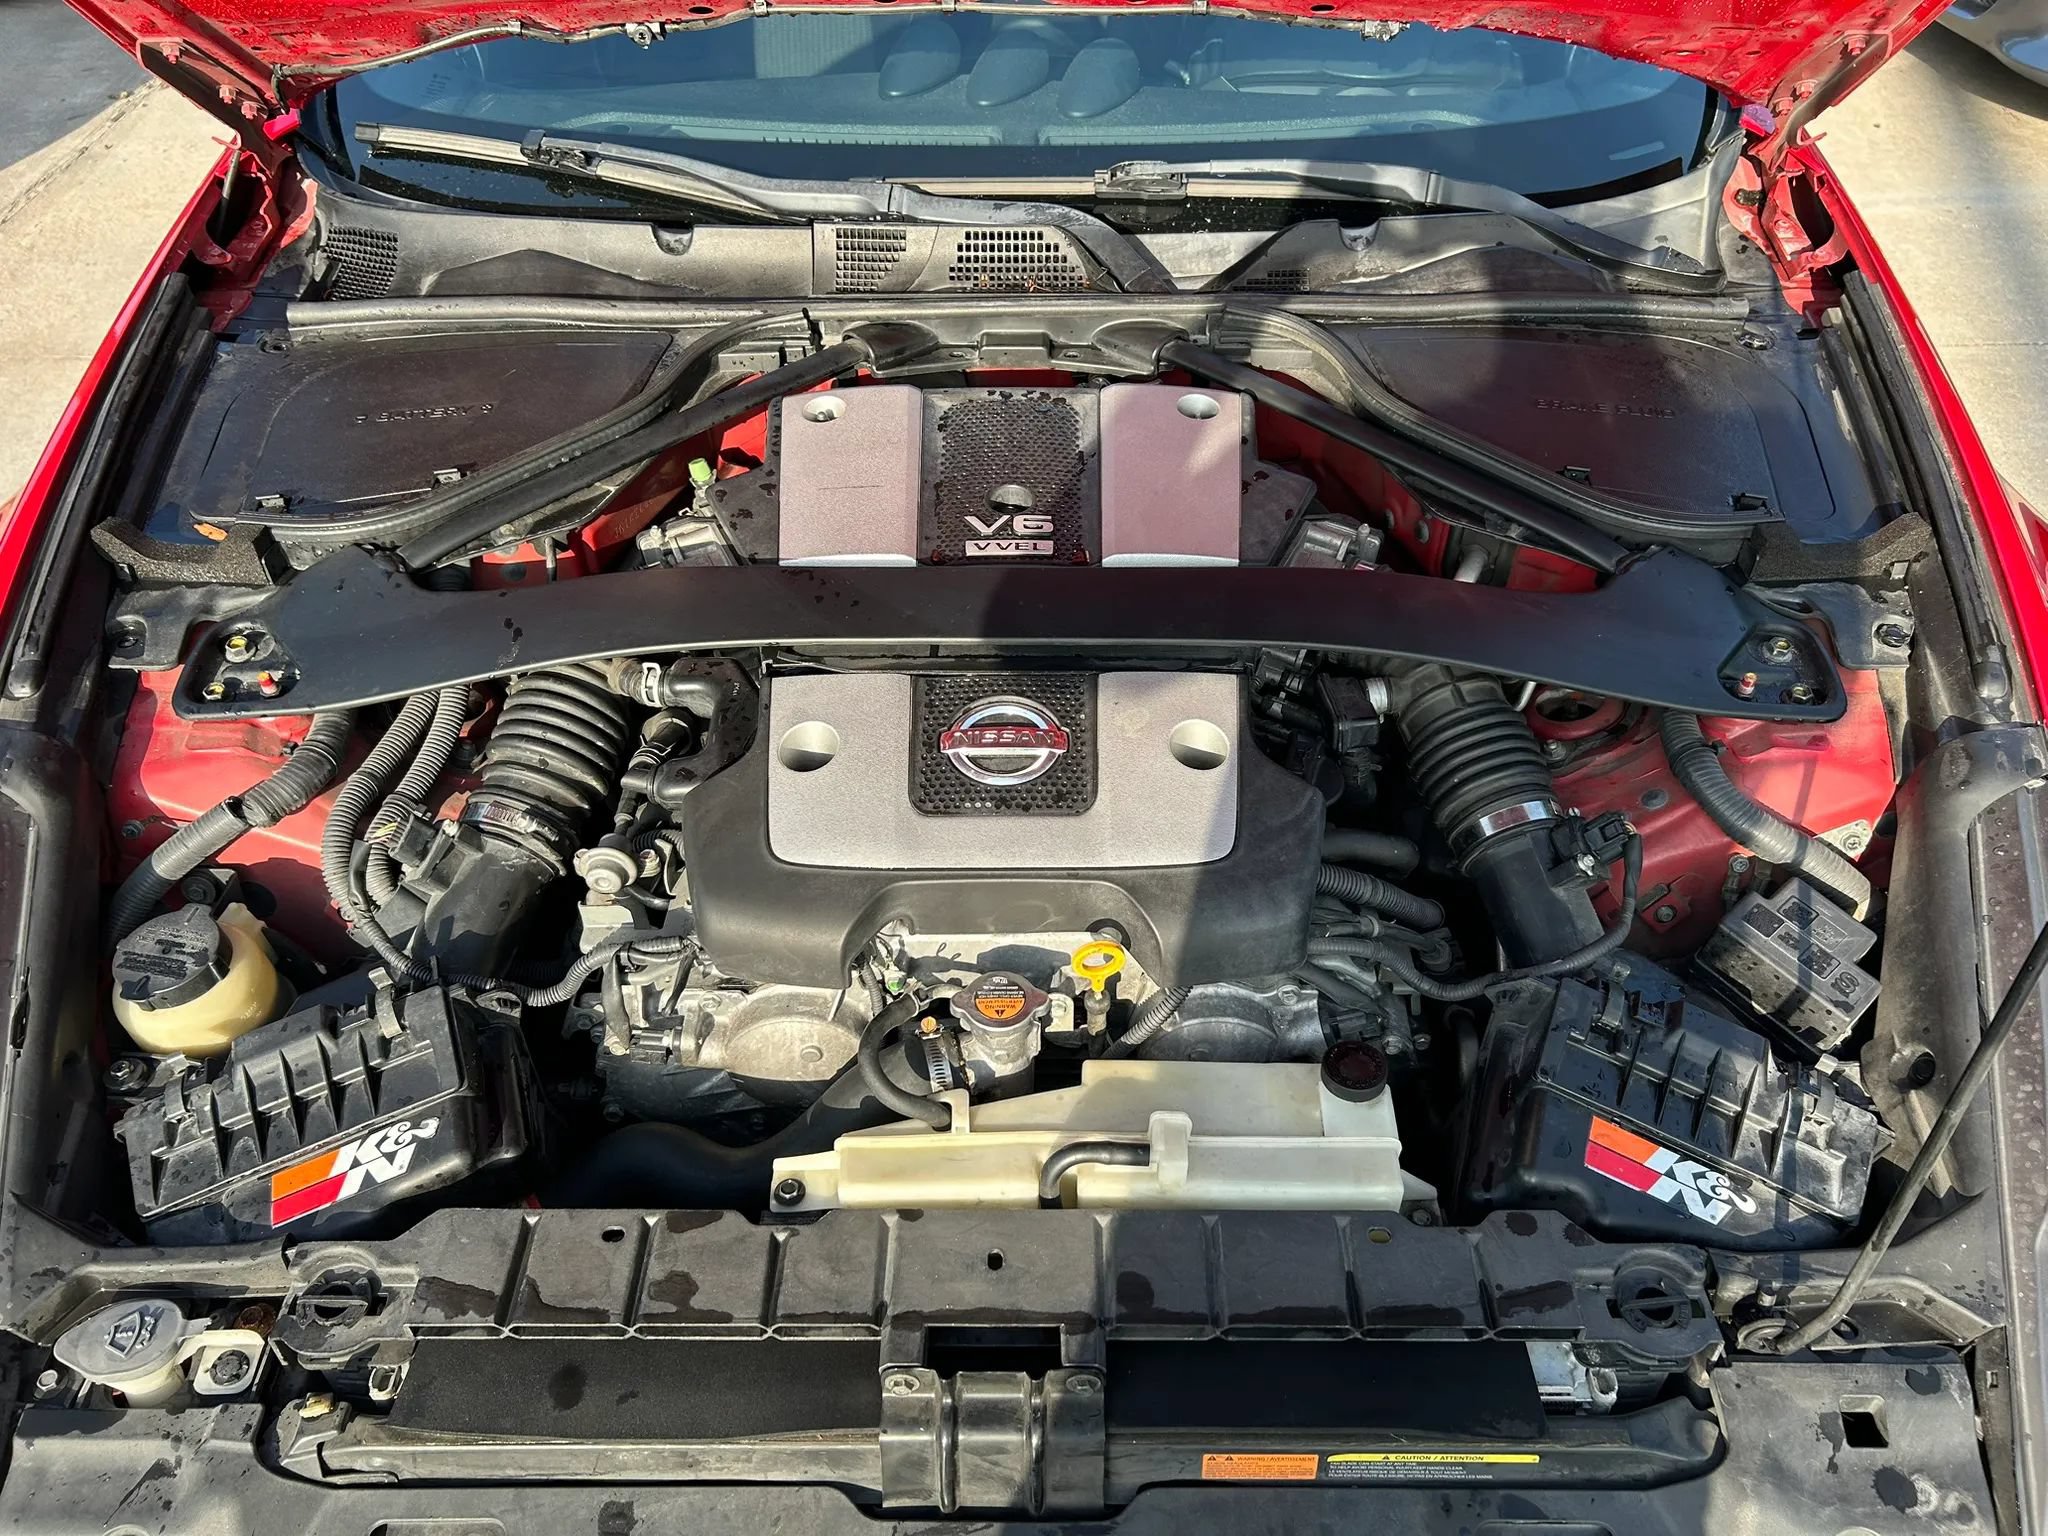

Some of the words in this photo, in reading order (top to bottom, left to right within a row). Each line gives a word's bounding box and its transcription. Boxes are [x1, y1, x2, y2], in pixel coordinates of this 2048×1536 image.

[375, 404, 476, 422] BATTERY
[1537, 399, 1609, 413] BRAKE
[1617, 404, 1675, 419] FLUID
[963, 514, 1054, 536] V6
[973, 542, 1047, 551] VVEL
[953, 730, 1055, 745] NISSAN
[328, 1117, 440, 1202] K&N
[1642, 1147, 1760, 1226] K&N
